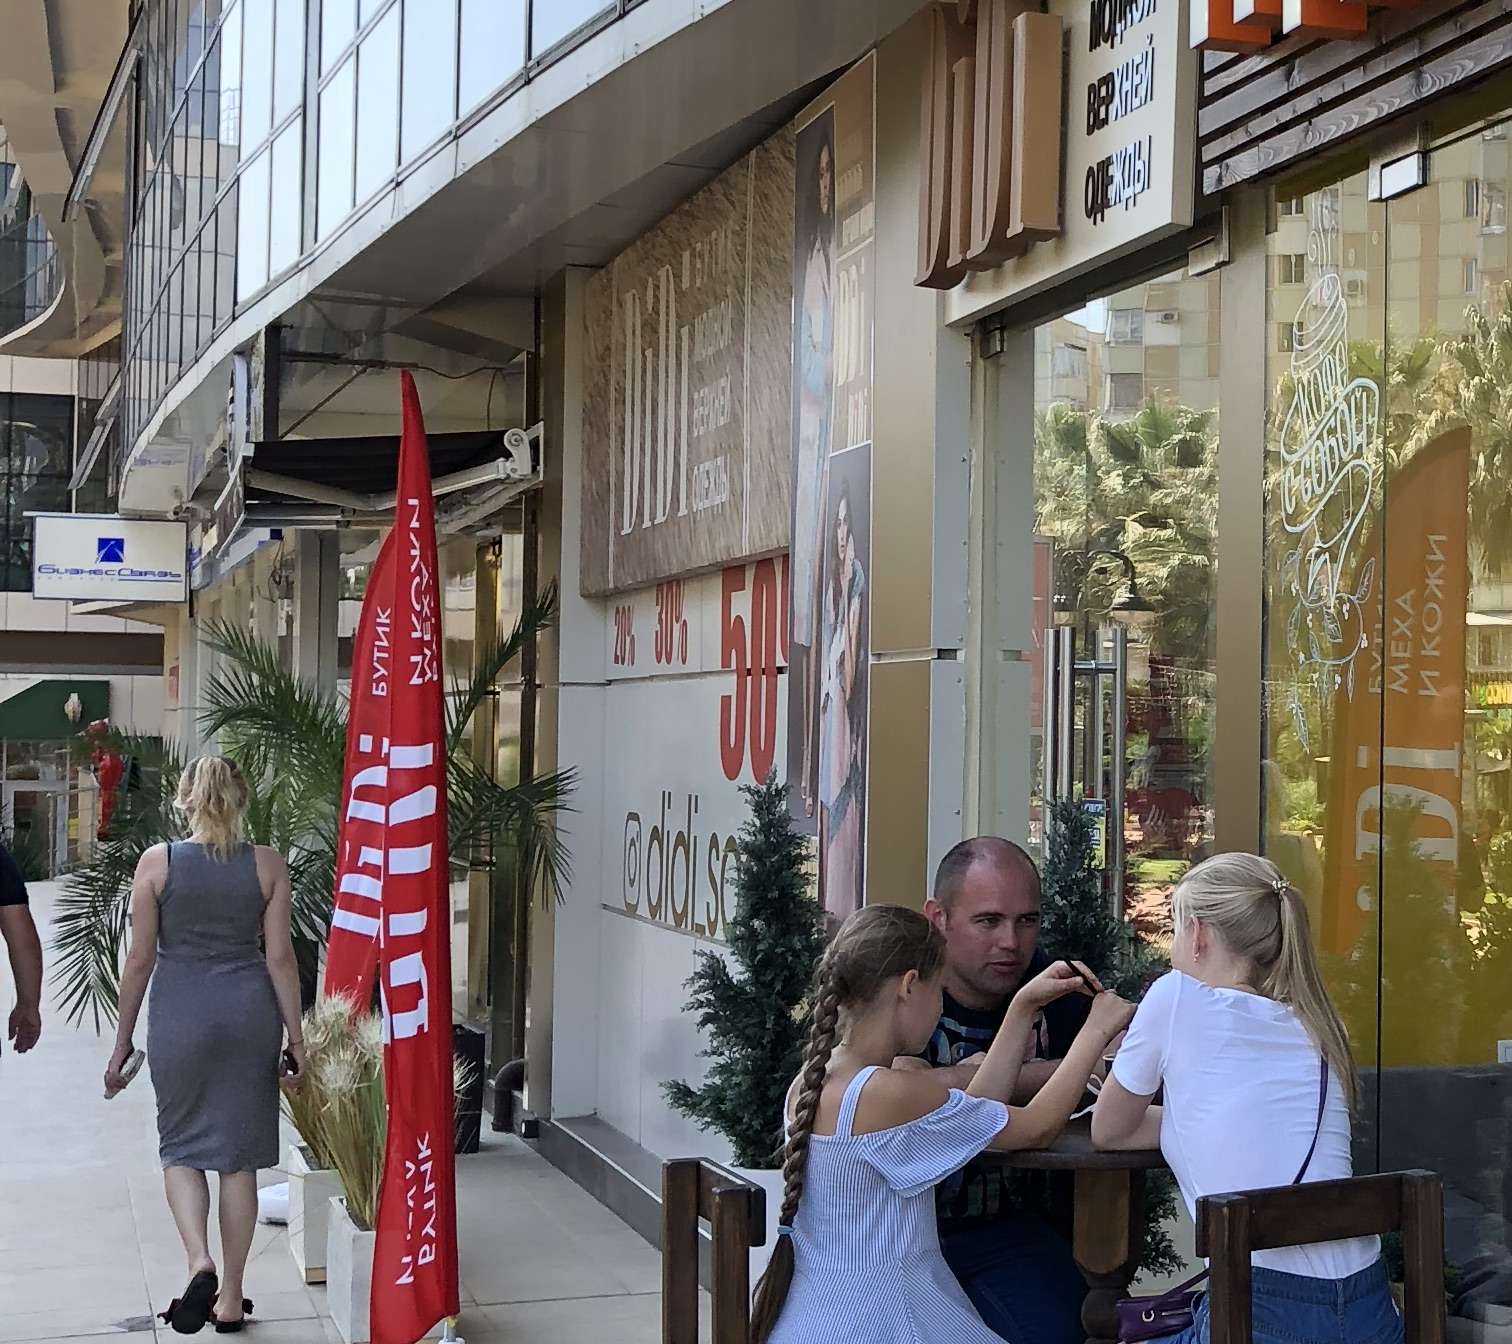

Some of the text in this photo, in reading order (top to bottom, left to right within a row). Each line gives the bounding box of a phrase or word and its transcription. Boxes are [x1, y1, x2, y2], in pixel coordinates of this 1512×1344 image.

[1086, 33, 1155, 137] ВЕРХНЕЙ
[1084, 135, 1152, 226] ОДЕЖДЫ
[371, 606, 392, 698] БУТИК
[613, 605, 636, 667] 20%
[1388, 588, 1416, 695] МЕХА
[1418, 534, 1449, 697] И КОЖИ
